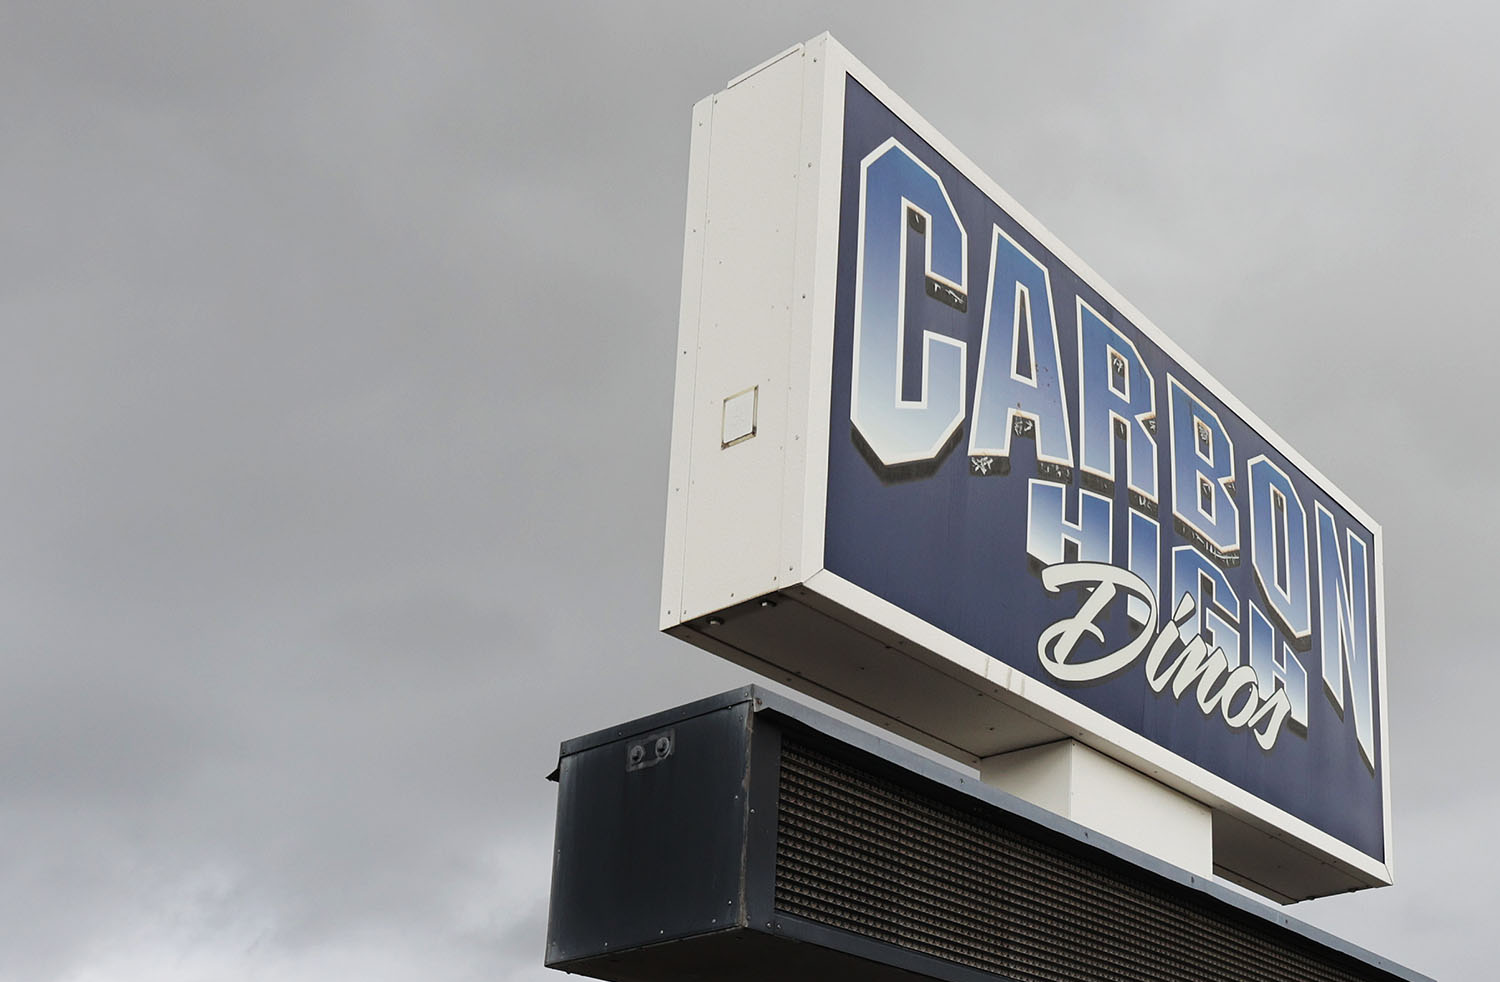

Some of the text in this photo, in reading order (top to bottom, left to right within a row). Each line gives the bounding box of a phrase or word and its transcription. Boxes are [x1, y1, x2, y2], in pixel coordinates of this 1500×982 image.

[850, 137, 1376, 764] CARBON
[1027, 479, 1309, 728] HIGH
[1037, 562, 1292, 751] Dinos
